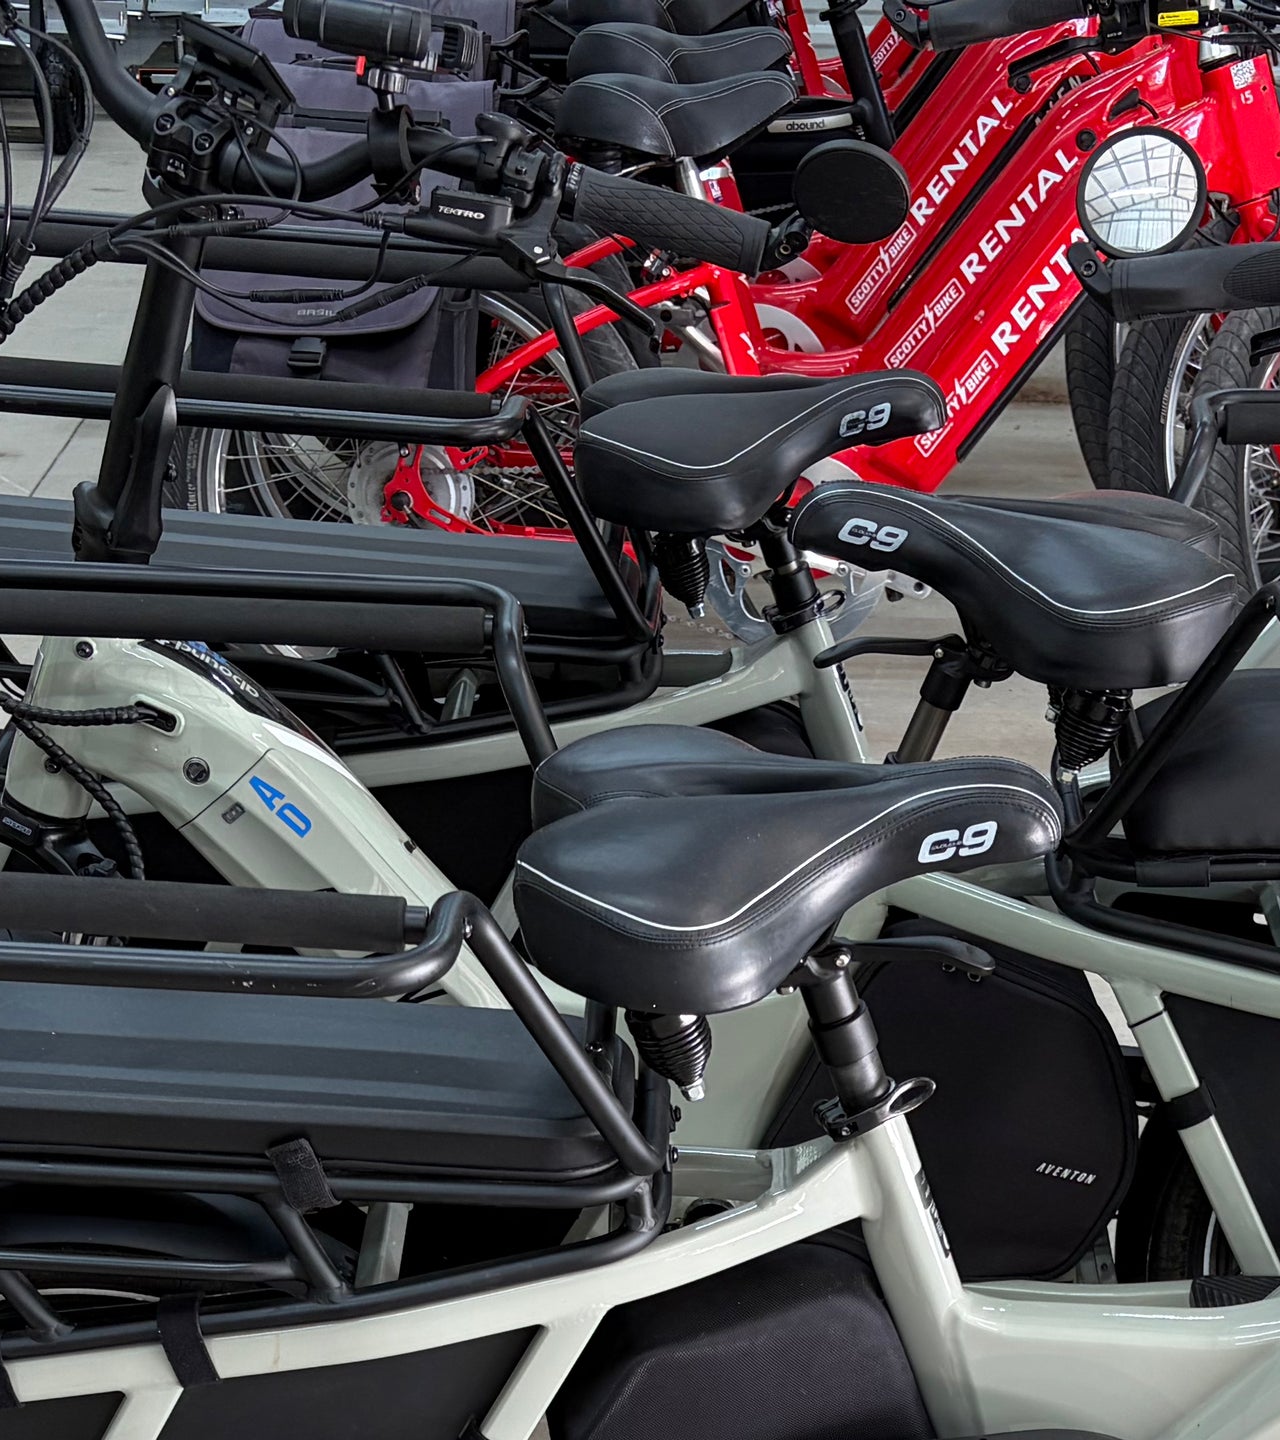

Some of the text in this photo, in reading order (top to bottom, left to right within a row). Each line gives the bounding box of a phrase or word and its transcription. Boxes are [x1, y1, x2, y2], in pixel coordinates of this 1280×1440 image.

[873, 36, 895, 68] COTTY
[1240, 90, 1254, 105] 15
[785, 119, 825, 131] abound
[910, 96, 1013, 226] RENTAL
[438, 205, 486, 220] TEKTRO
[959, 149, 1078, 284] RENTAL
[851, 229, 912, 308] SCOTTY BIKE
[889, 287, 959, 368] SCOTTY BIKE
[965, 358, 992, 393] BIKE
[839, 402, 892, 438] C9
[837, 507, 909, 553] C9
[248, 775, 312, 838] AD
[917, 820, 998, 864] C9
[1035, 1162, 1097, 1185] AVENTON
